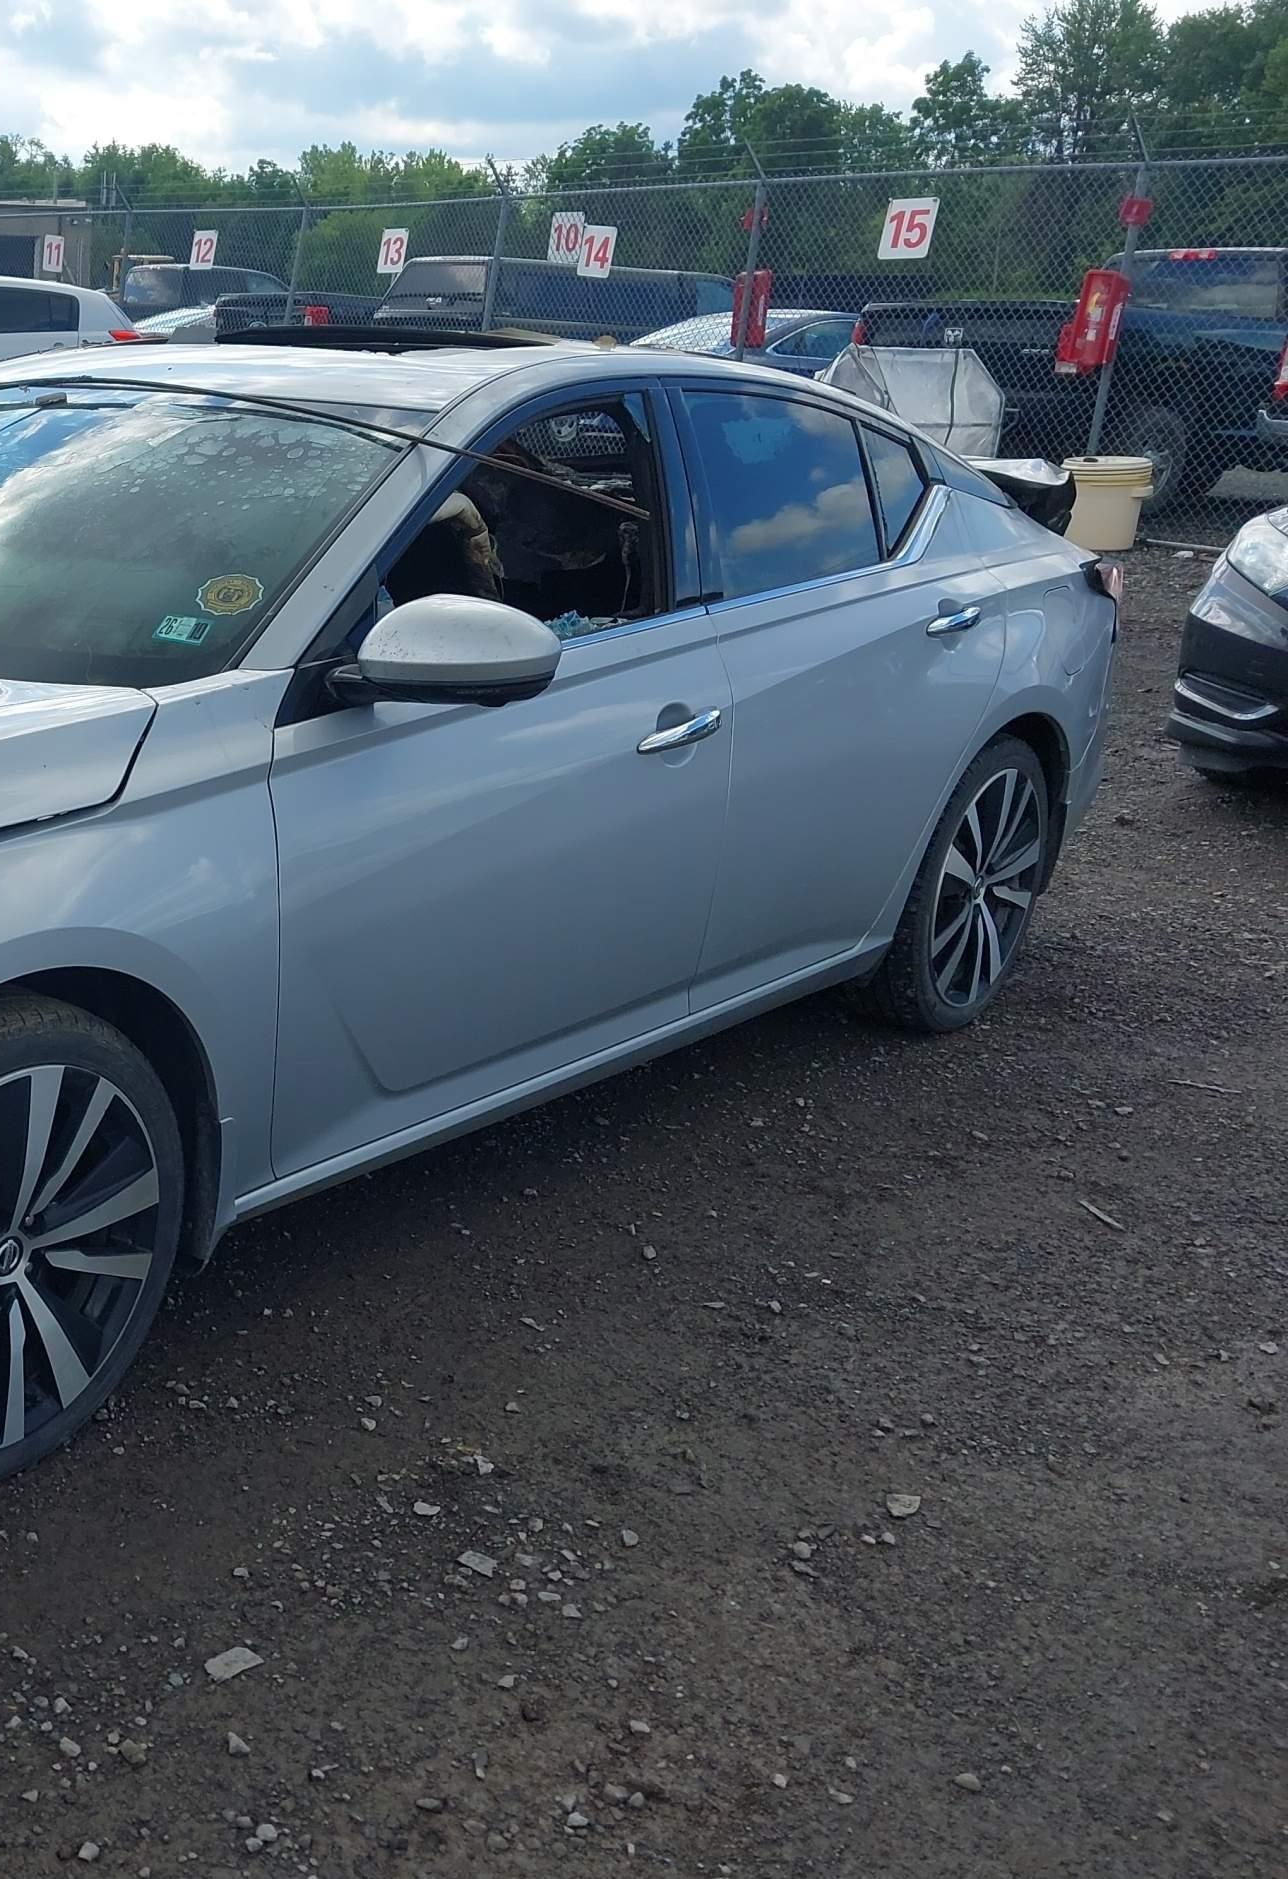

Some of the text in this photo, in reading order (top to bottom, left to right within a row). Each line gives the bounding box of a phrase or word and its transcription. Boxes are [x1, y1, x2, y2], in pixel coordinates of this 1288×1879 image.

[554, 223, 579, 252] 10
[889, 209, 931, 249] 15
[46, 241, 62, 267] 11
[195, 237, 214, 264] 12
[383, 236, 404, 265] 13
[584, 235, 610, 269] 14
[158, 617, 178, 635] 26
